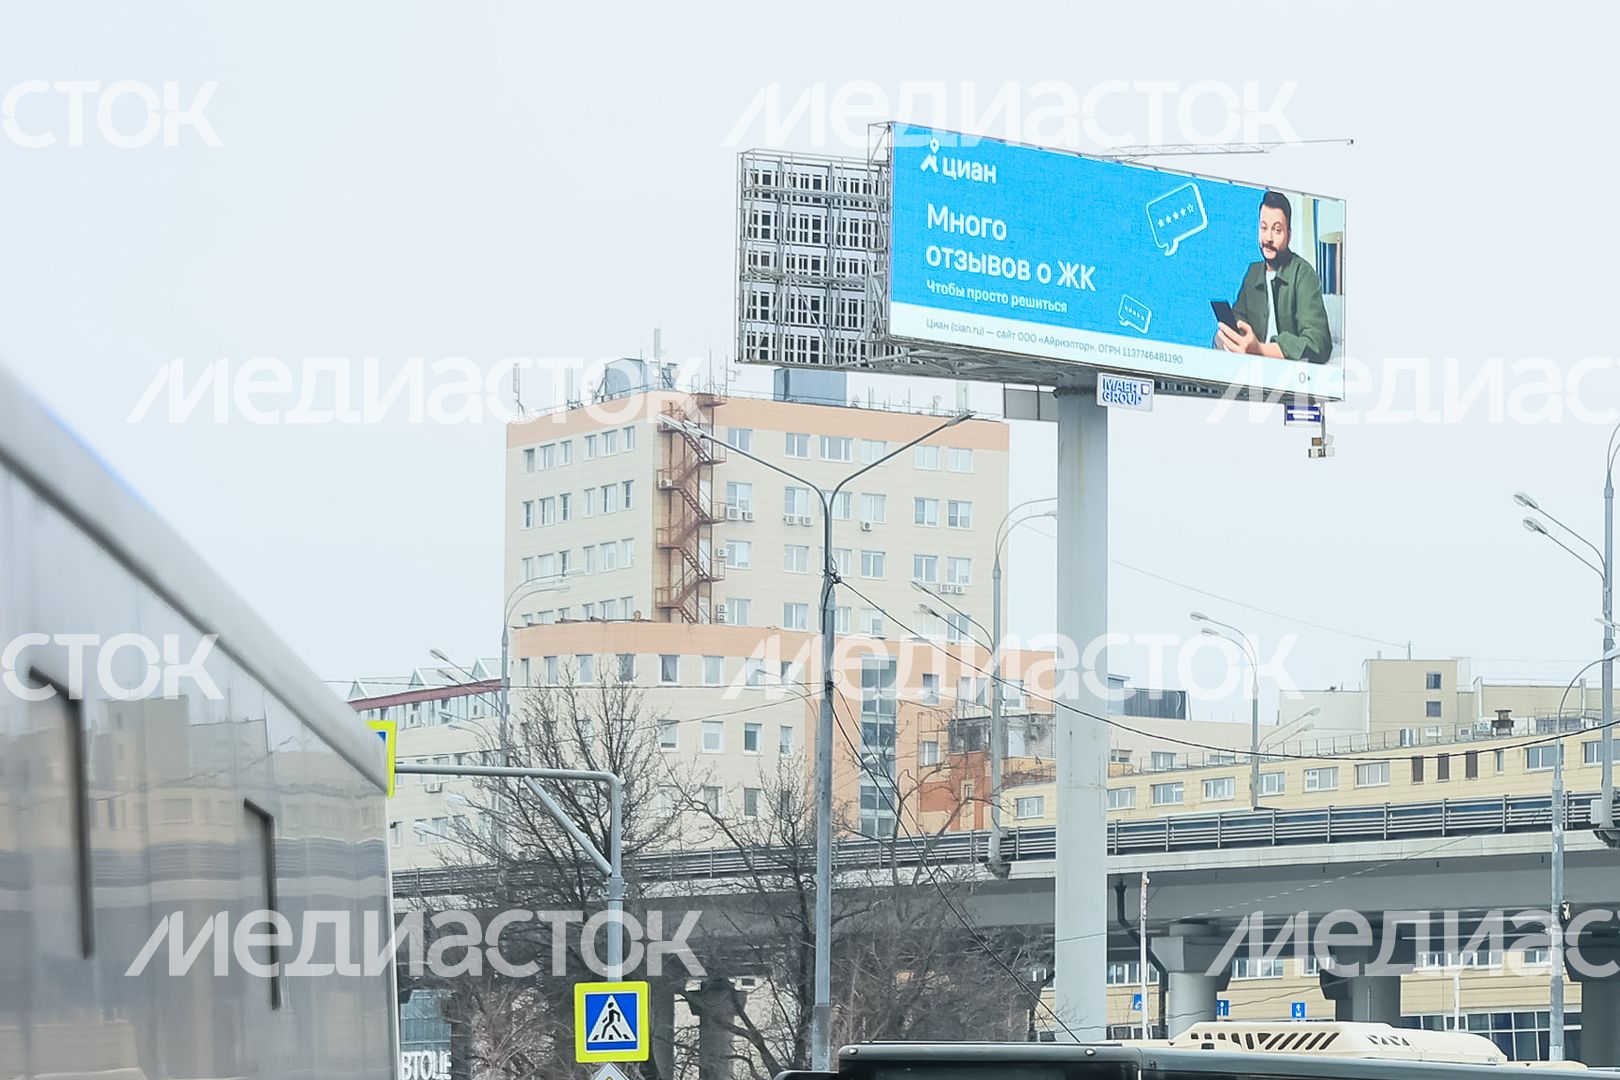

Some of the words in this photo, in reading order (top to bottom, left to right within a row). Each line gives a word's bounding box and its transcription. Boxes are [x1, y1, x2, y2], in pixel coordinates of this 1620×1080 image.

[942, 156, 998, 184] циан
[927, 202, 1007, 241] Много
[925, 245, 1031, 282] отзывов
[1036, 262, 1053, 284] о
[1057, 260, 1097, 292] ЖК
[926, 279, 965, 298] Чтобы
[966, 288, 1009, 306] просто
[1011, 295, 1069, 314] решиться
[926, 318, 949, 331] Циан
[951, 320, 985, 337] (cian.ru)
[996, 330, 1016, 342] сайт
[1017, 331, 1037, 344] ООО
[1098, 342, 1121, 356] ОГРН
[1102, 377, 1138, 394] MAER
[1102, 391, 1143, 406] GROUP
